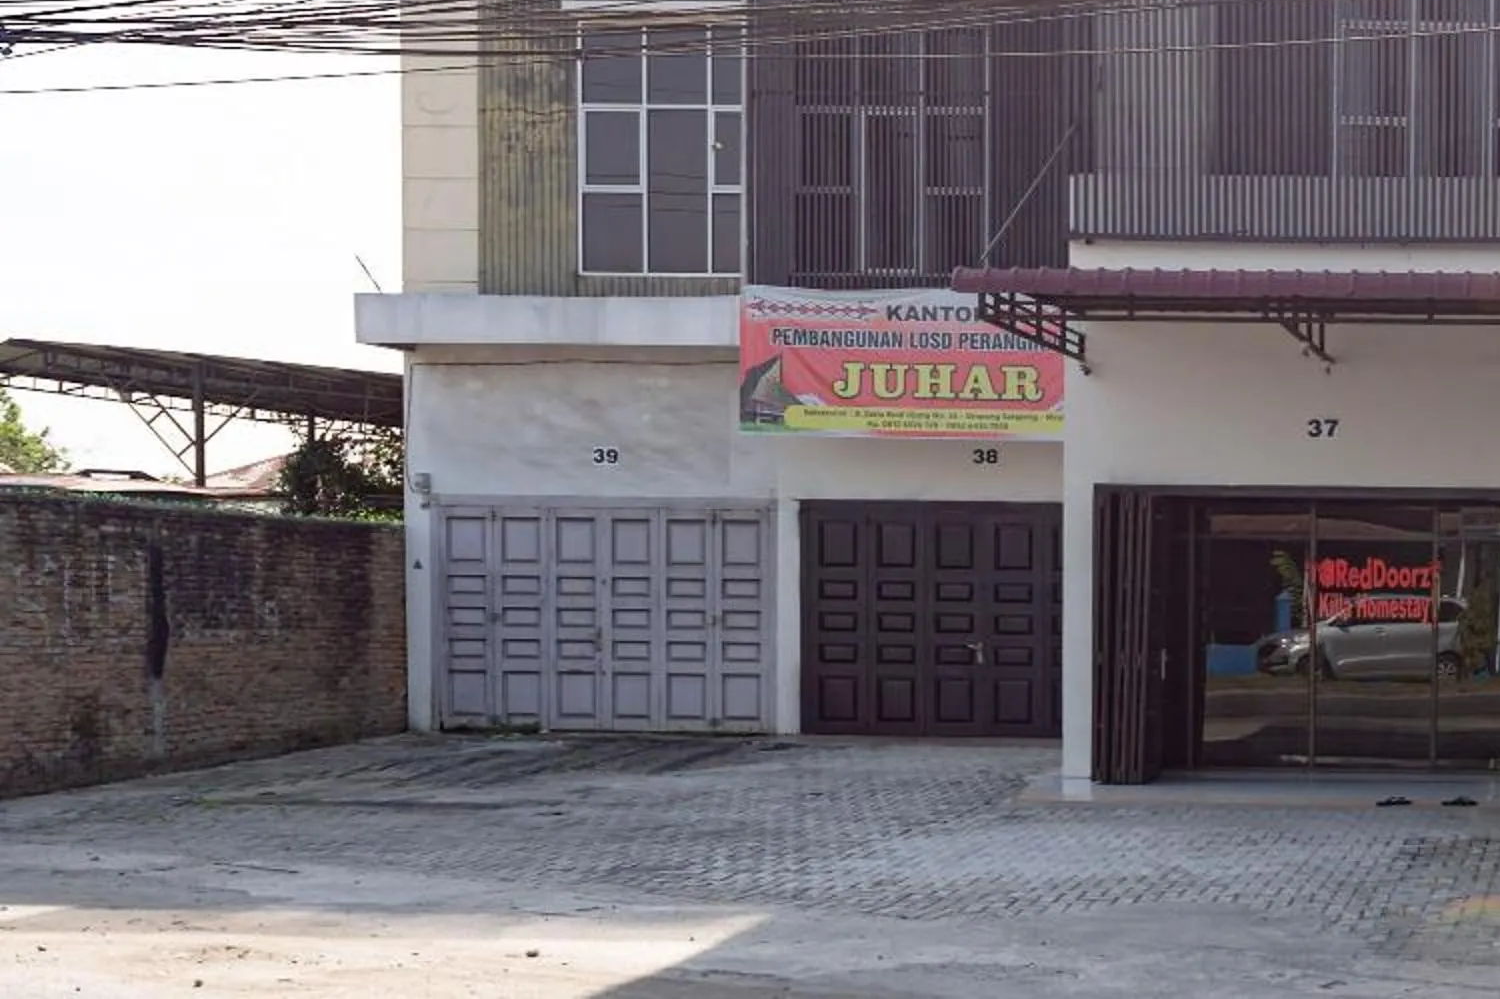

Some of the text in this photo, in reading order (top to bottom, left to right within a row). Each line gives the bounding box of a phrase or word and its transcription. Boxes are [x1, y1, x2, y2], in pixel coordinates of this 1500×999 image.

[886, 304, 980, 322] KANTO
[773, 327, 903, 349] PEMBANGUNAN
[832, 361, 1044, 401] JUHAR
[1307, 418, 1340, 438] 37
[592, 448, 619, 464] 39
[973, 448, 998, 464] 38
[1356, 594, 1431, 625] Homestay
